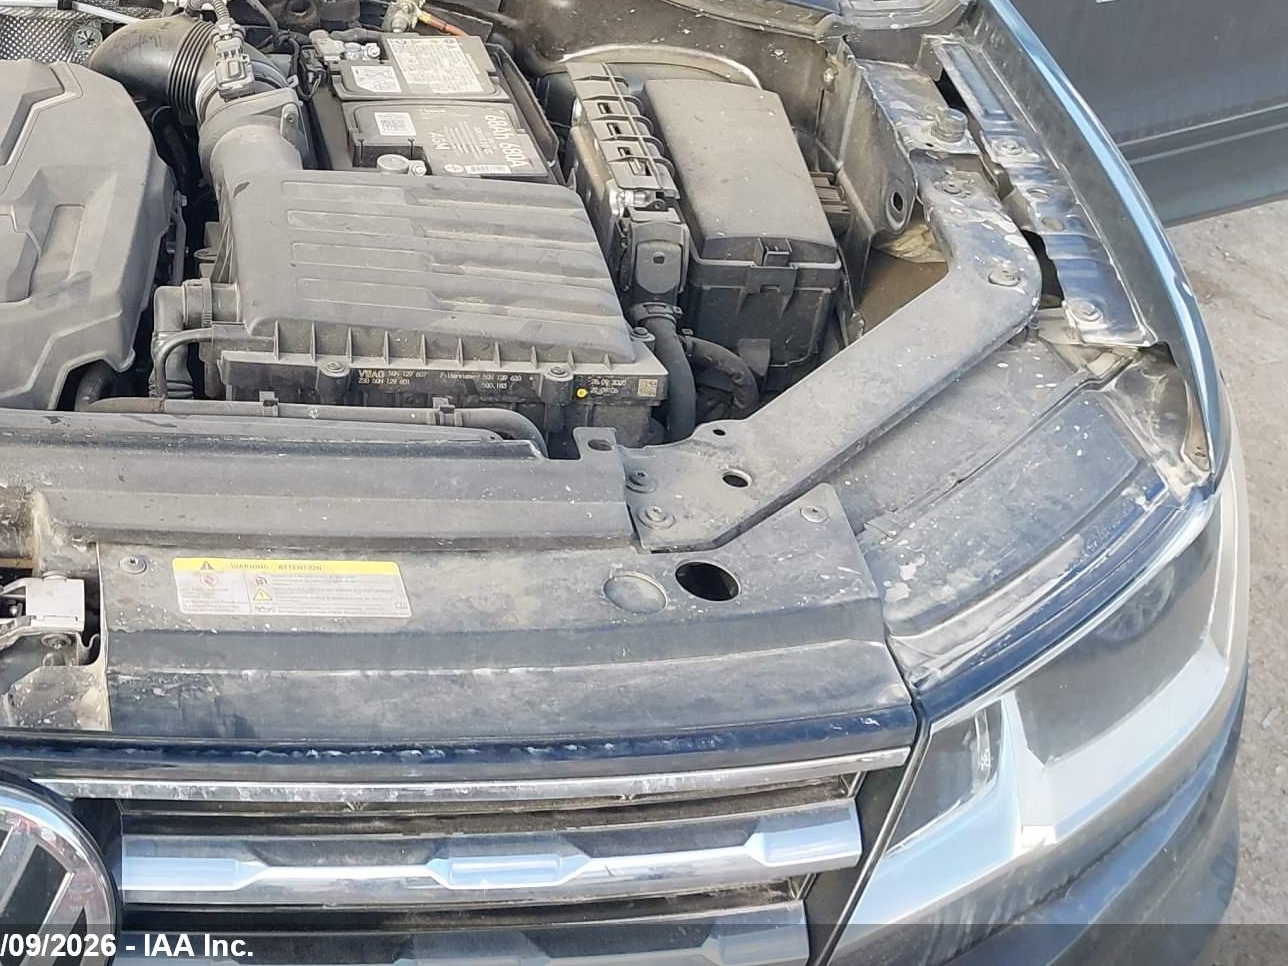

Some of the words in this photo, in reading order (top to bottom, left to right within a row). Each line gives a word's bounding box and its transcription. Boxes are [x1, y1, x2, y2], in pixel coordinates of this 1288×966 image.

[429, 131, 451, 151] AGM
[484, 114, 512, 140] 68Ah
[498, 142, 530, 168] 680A
[230, 563, 269, 571] WARNING
[278, 564, 322, 572] ATTENTION
